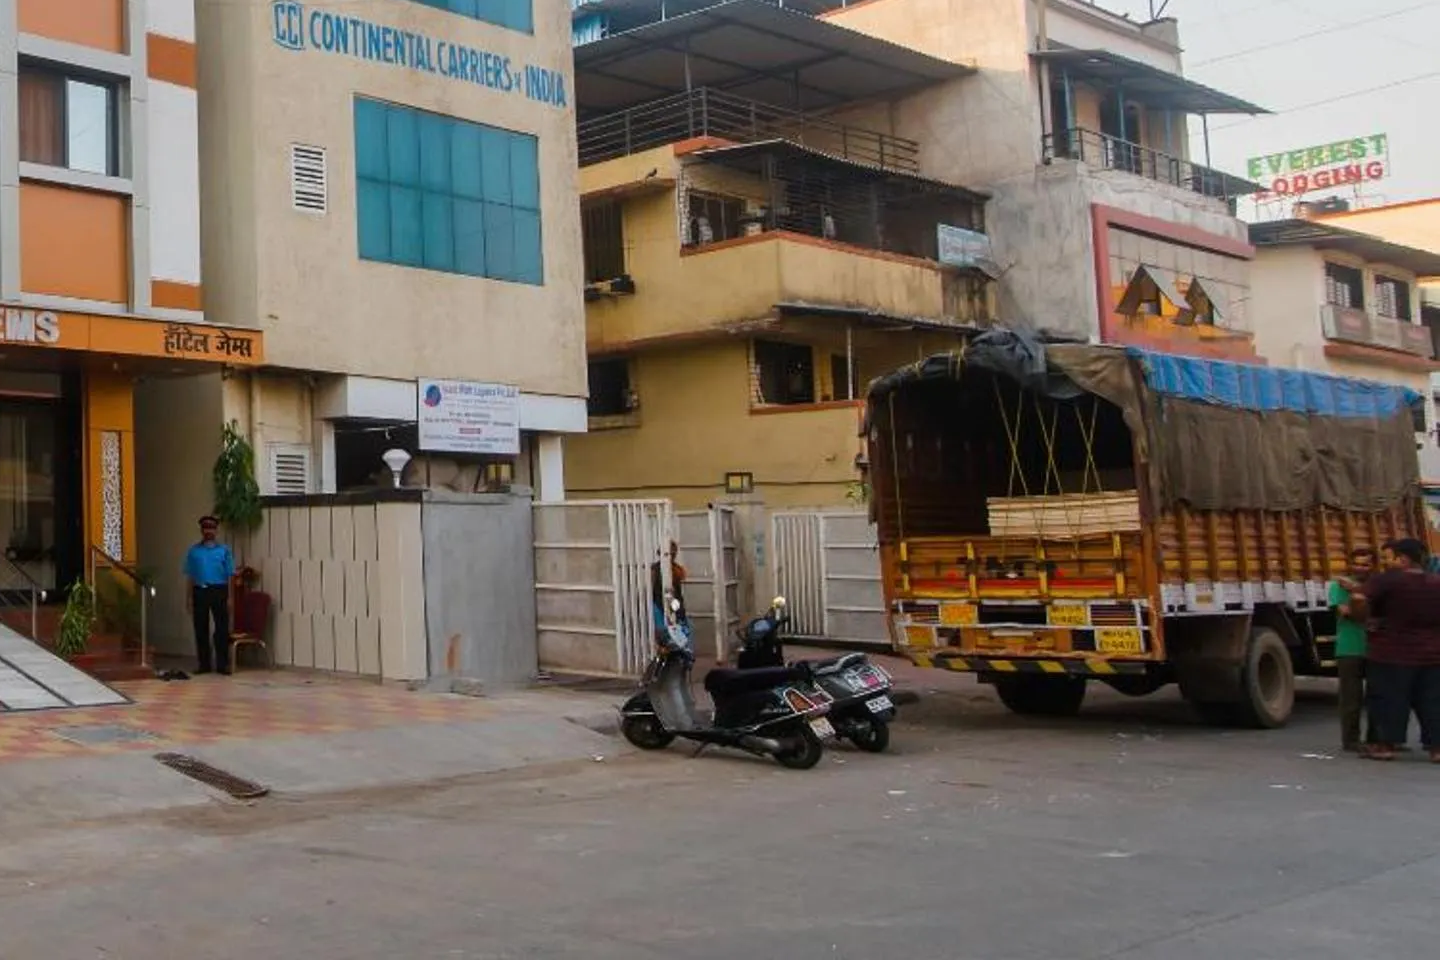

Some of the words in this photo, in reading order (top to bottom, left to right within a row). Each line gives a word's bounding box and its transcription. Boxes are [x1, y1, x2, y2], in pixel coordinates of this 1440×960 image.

[310, 10, 436, 73] CONTINENTAL
[437, 41, 513, 92] CARRIERS
[525, 63, 567, 109] INDIA
[1247, 133, 1387, 179] EVEREST
